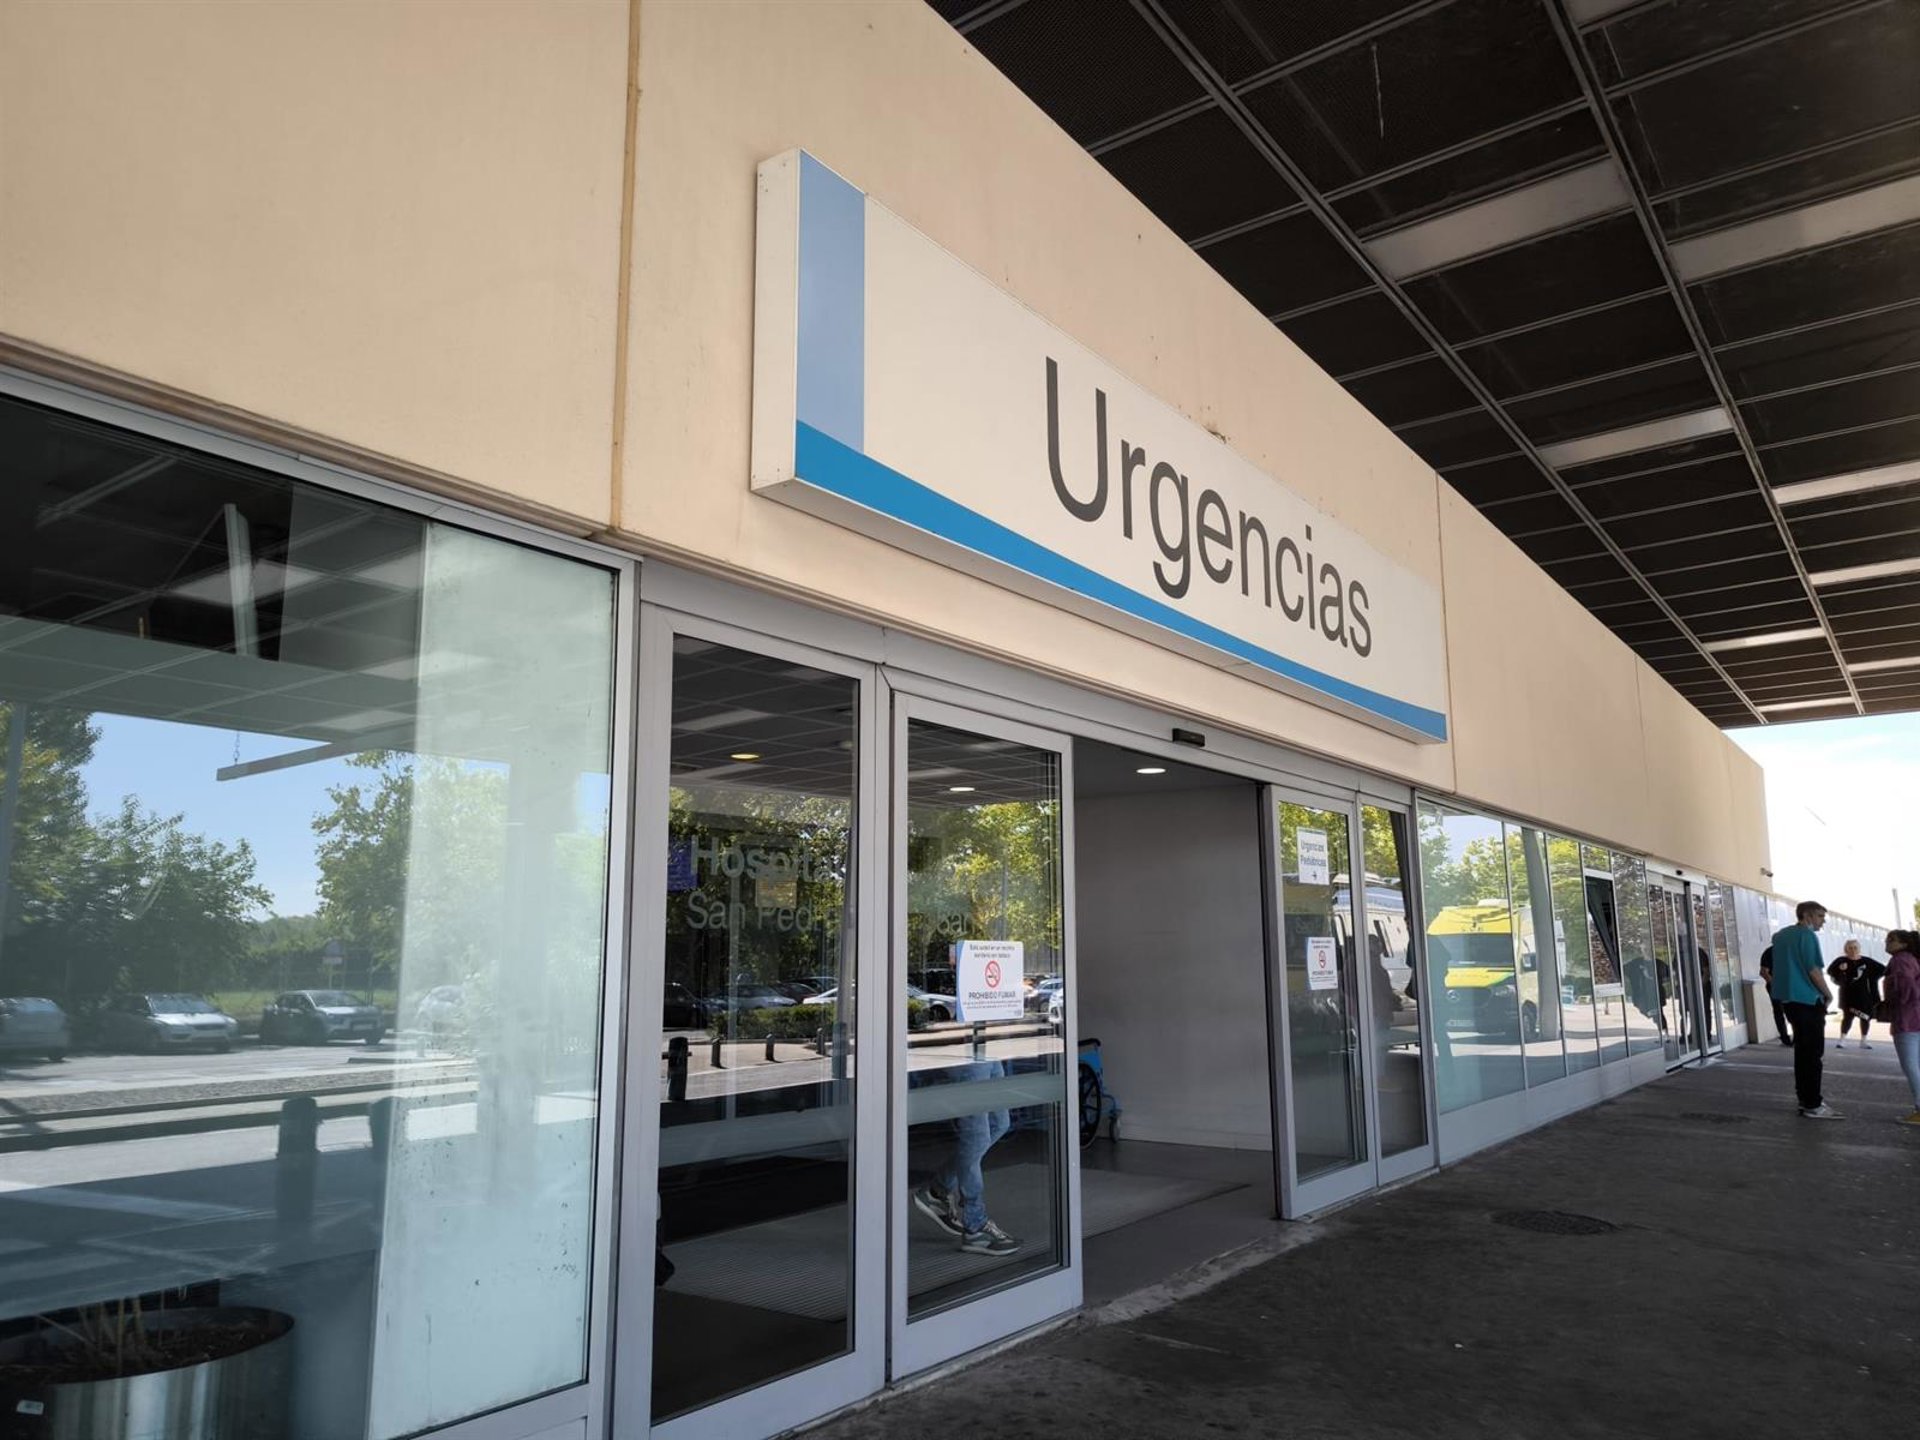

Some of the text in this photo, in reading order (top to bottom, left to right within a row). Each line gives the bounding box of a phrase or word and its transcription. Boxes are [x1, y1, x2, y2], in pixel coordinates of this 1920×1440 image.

[1046, 356, 1372, 658] Urgencias
[1300, 840, 1325, 852] Urgencias
[686, 890, 746, 930] San
[968, 990, 1016, 999] PROHIBIDO FUMAR
